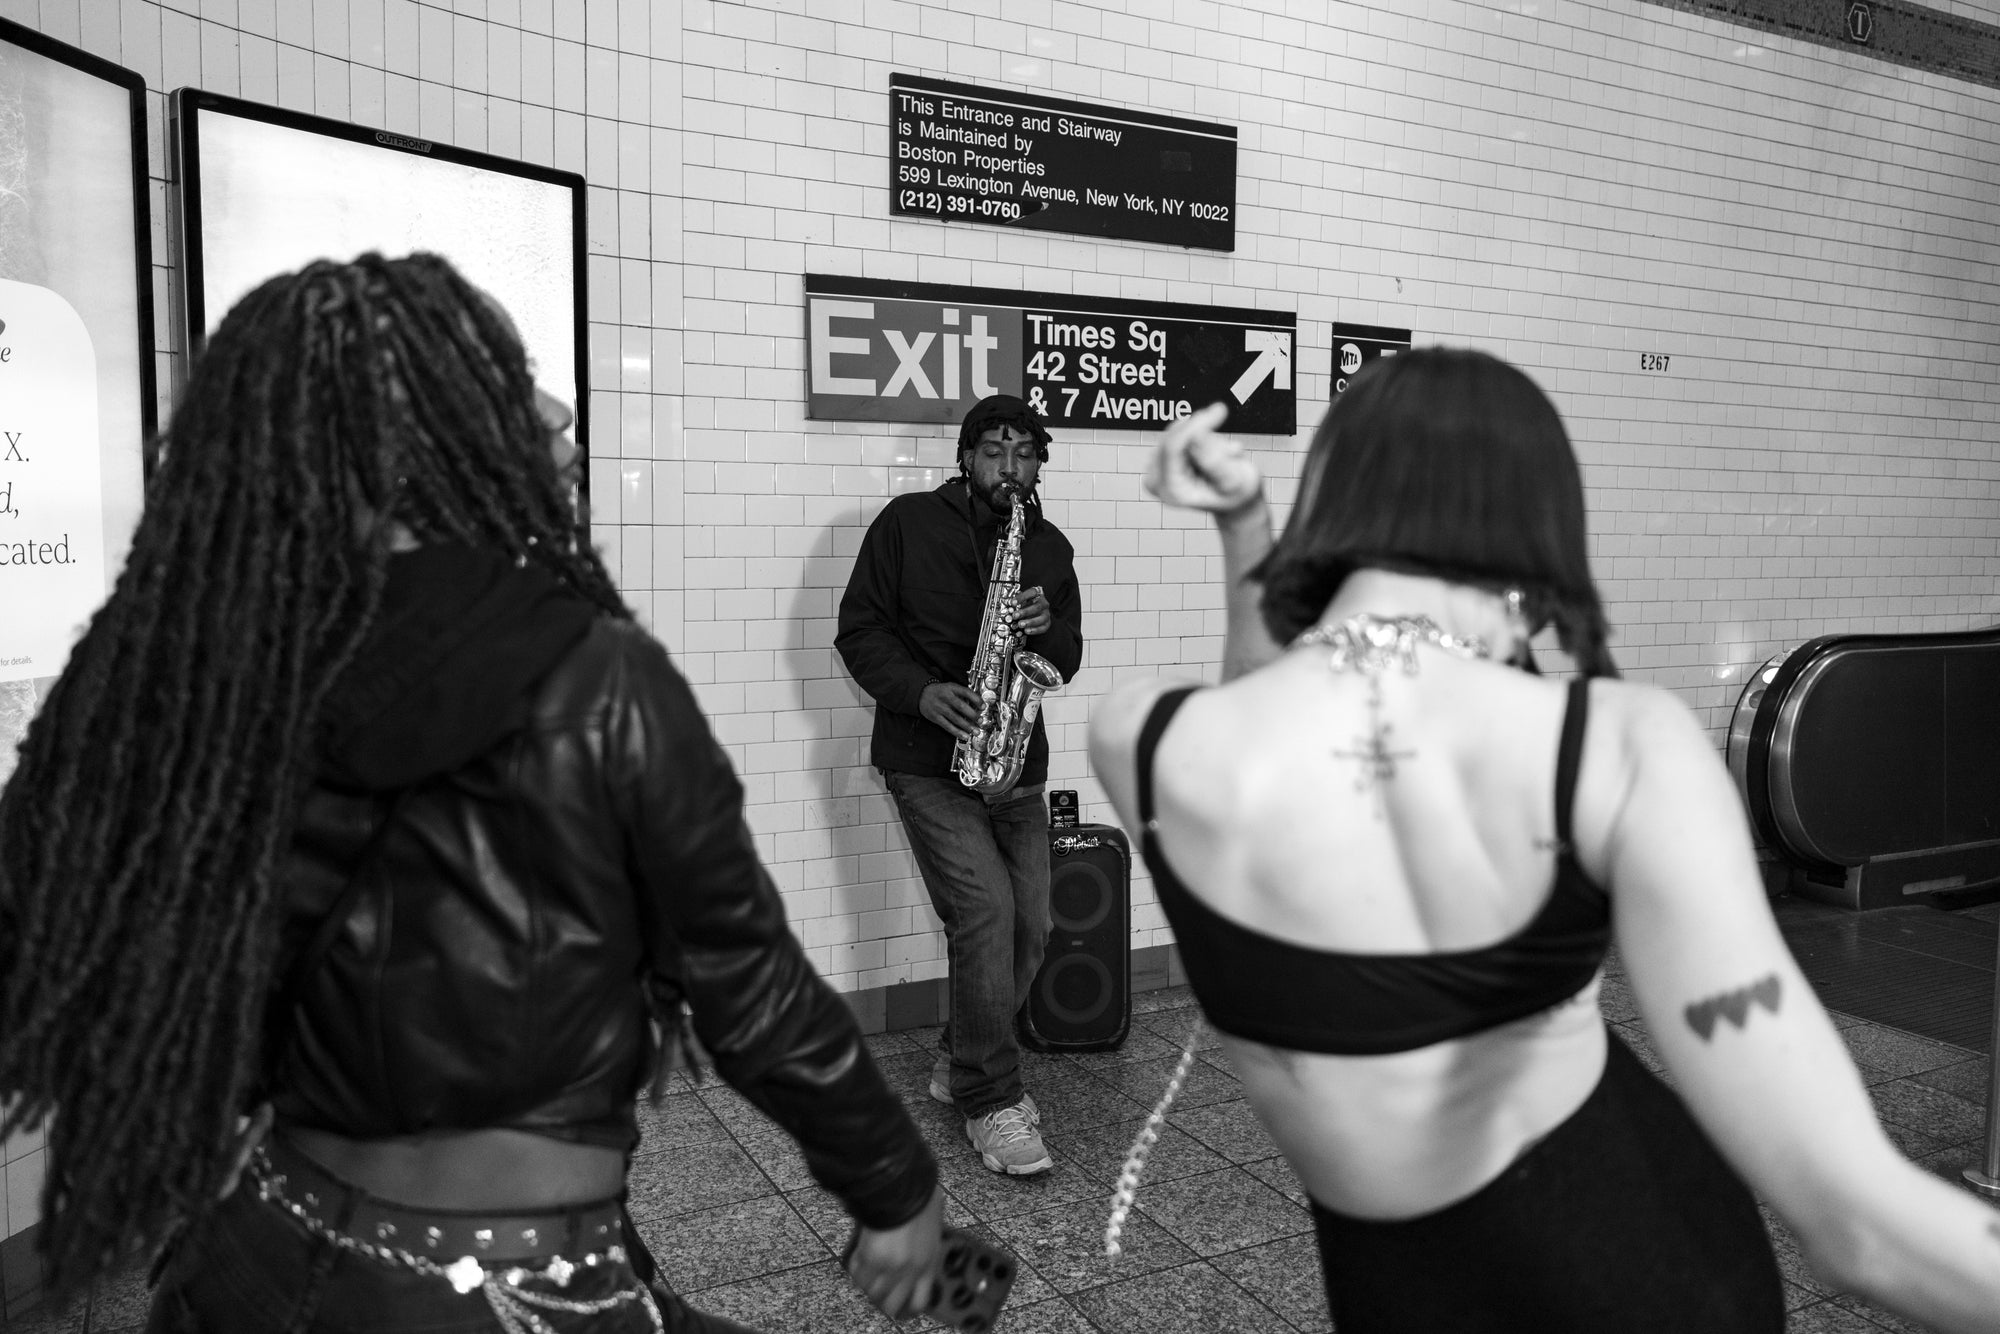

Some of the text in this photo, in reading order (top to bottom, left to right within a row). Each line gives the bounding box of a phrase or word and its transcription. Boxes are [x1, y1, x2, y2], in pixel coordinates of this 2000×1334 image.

[898, 94, 1122, 147] This Entrance and Stairway
[898, 118, 1033, 156] is Maintained by
[898, 141, 1046, 176] Boston Properties
[899, 165, 1229, 222] 599 Lexington Avenue, New York, NY 10022
[900, 189, 1021, 219] (212) 391-0760
[810, 298, 999, 400] Exit
[1027, 314, 1167, 358] Times Sq
[1026, 351, 1167, 386] 42 Street
[1641, 353, 1670, 372] E267
[1027, 386, 1192, 421] & 7 Avenue
